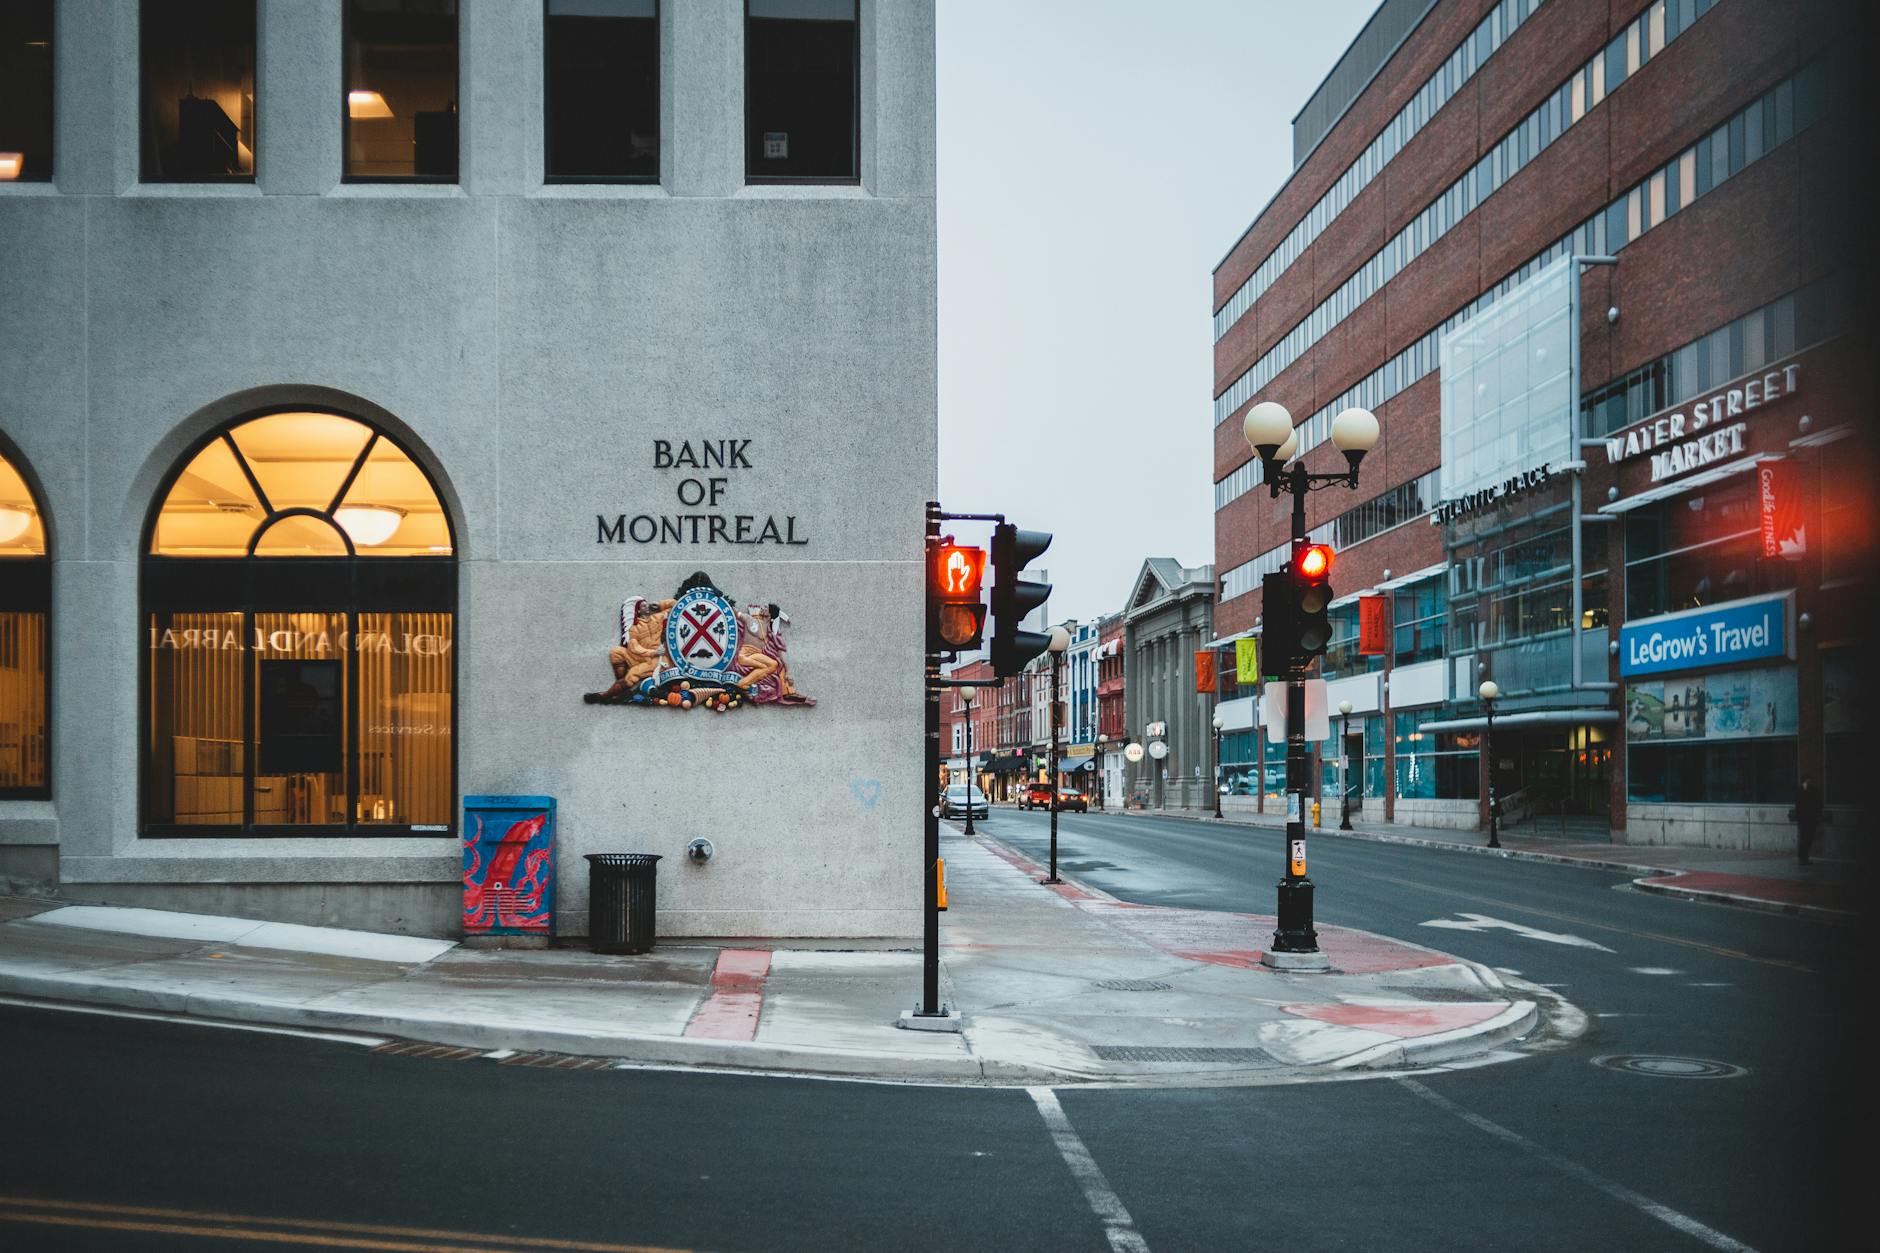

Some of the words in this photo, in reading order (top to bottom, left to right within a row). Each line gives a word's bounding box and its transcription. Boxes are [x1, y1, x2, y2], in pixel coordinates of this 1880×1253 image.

[1606, 413, 1686, 464] WATER
[1693, 364, 1800, 430] STREET
[653, 439, 753, 469] BANK
[1650, 423, 1747, 482] MARKET
[677, 477, 728, 507] OF
[596, 514, 809, 545] MONTREAL
[1763, 514, 1776, 558] FITNESS
[668, 592, 719, 650] CONCORDIA
[722, 606, 736, 650] SALUS
[1630, 625, 1708, 666] LeGrow's
[1710, 613, 1769, 655] Travel
[688, 668, 698, 676] OF
